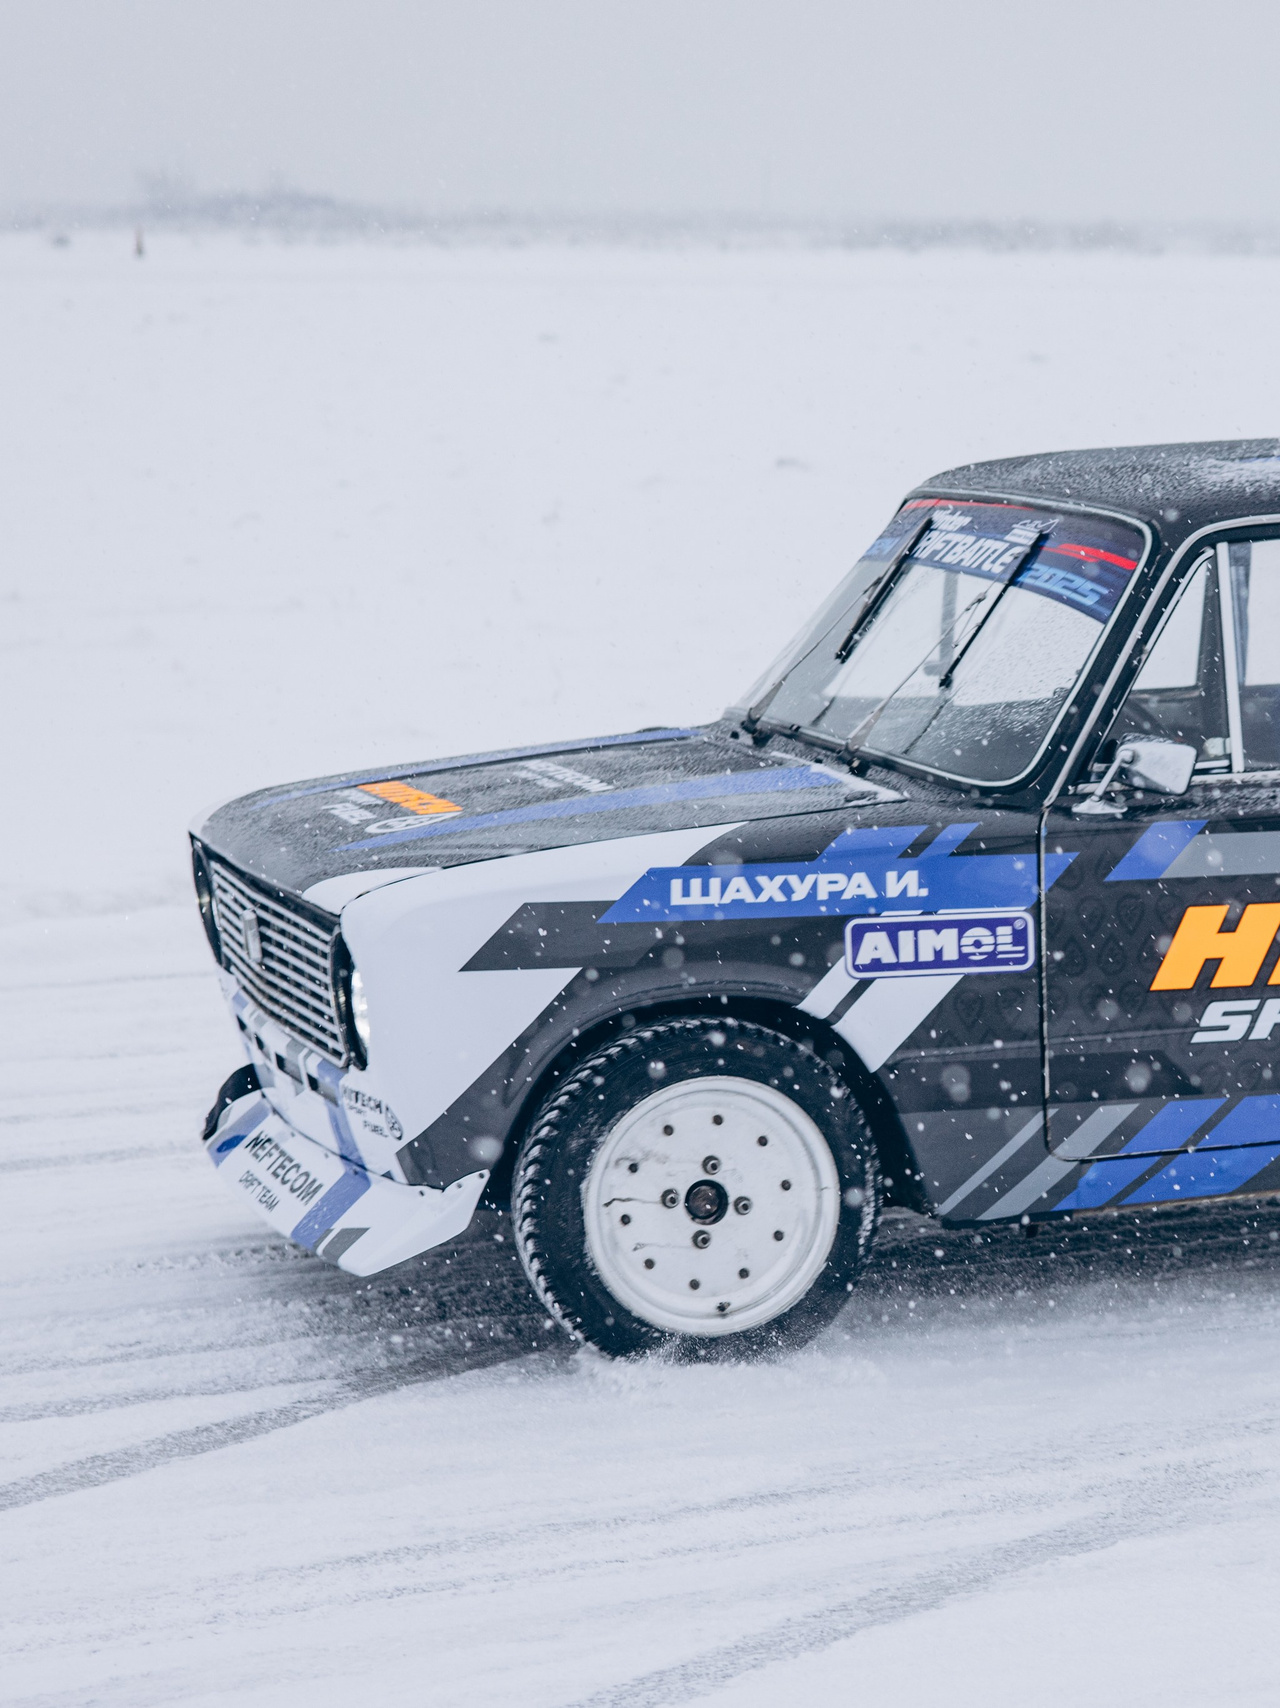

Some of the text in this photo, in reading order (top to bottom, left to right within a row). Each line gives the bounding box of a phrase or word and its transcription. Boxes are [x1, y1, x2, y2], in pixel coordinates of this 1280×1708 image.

[908, 529, 1028, 575] RIFTBATTLE
[1017, 562, 1110, 605] 2025
[669, 869, 929, 907] ШАХУРА И.
[853, 924, 1026, 967] AIMOL
[244, 1129, 324, 1206] NEFTECOM
[238, 1169, 281, 1213] DRIFT TEAM
